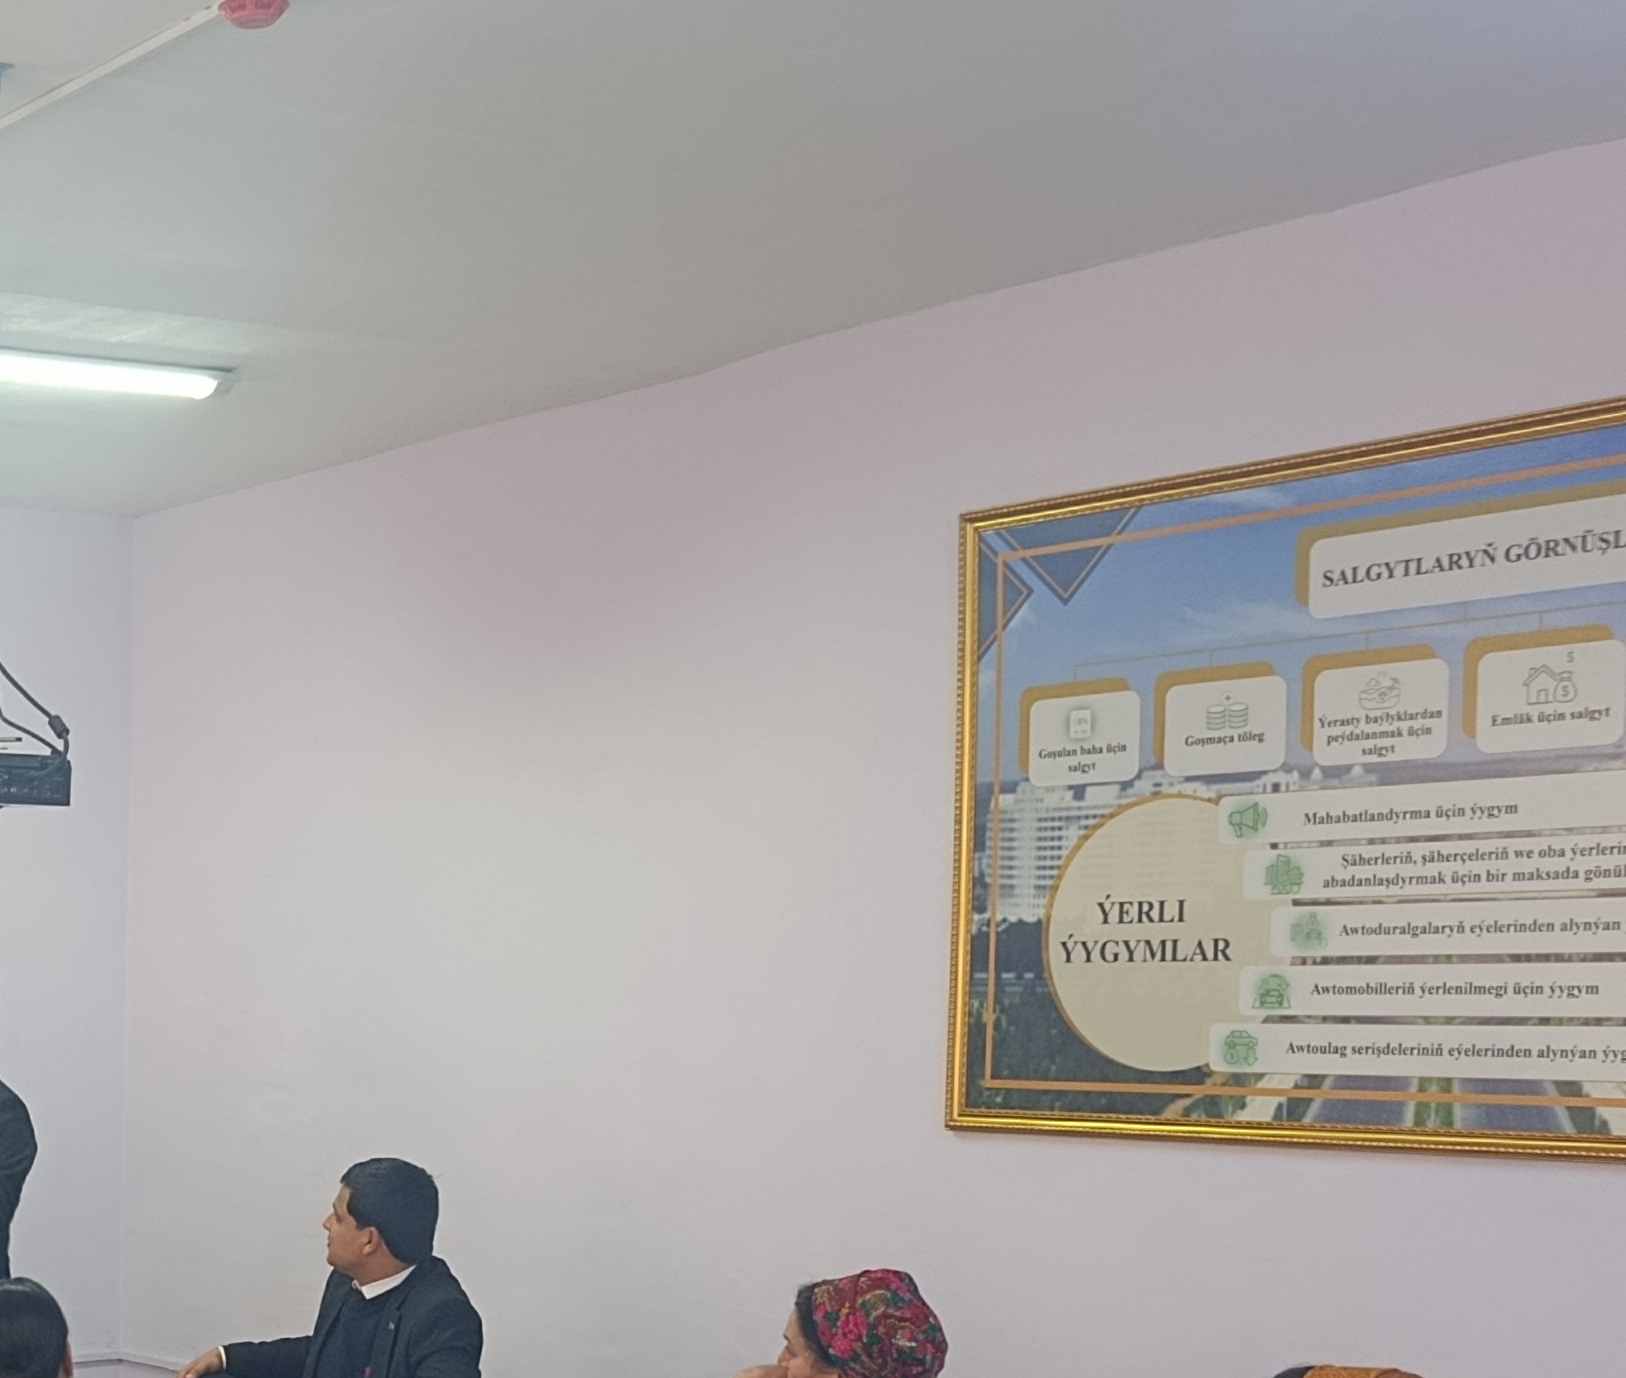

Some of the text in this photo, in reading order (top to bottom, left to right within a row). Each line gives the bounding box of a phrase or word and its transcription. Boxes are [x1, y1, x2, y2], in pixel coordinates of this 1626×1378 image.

[1321, 543, 1497, 588] SALGYTLARYŇ
[1318, 706, 1443, 730] Ýerasty baýlyklardan
[1490, 706, 1611, 727] Emläk üçin salgyt
[1184, 730, 1265, 748] Goşmaça töleg
[1326, 724, 1433, 747] peýdalanmak üçin
[1080, 742, 1105, 756] baha
[1107, 740, 1128, 756] üçin
[1362, 743, 1395, 759] salgyt
[1067, 760, 1097, 775] salgyt
[1302, 801, 1519, 826] Mahabatlandyrma üçin ýygym
[1341, 851, 1418, 870] Şäherleriň,
[1420, 846, 1510, 867] şäherçeleriň
[1513, 849, 1535, 860] we
[1538, 844, 1566, 859] oba
[1322, 870, 1446, 889] abadanlaşdyrmak
[1450, 867, 1481, 885] üçin
[1485, 865, 1508, 882] bir
[1511, 865, 1580, 882] maksada
[1096, 893, 1188, 926] ÝERLI
[1339, 917, 1622, 938] Awtoduralgalaryň eýelerinden alynýan
[1060, 933, 1233, 964] ÝYGYMLAR
[1310, 980, 1600, 999] Awtomobilleriň ýerlenilmegi üçin ýygym
[1286, 1042, 1348, 1058] Awtoulag
[1350, 1041, 1444, 1059] serişdeleriniň
[1448, 1042, 1533, 1061] eýelerinden
[1536, 1043, 1597, 1063] alynýan
